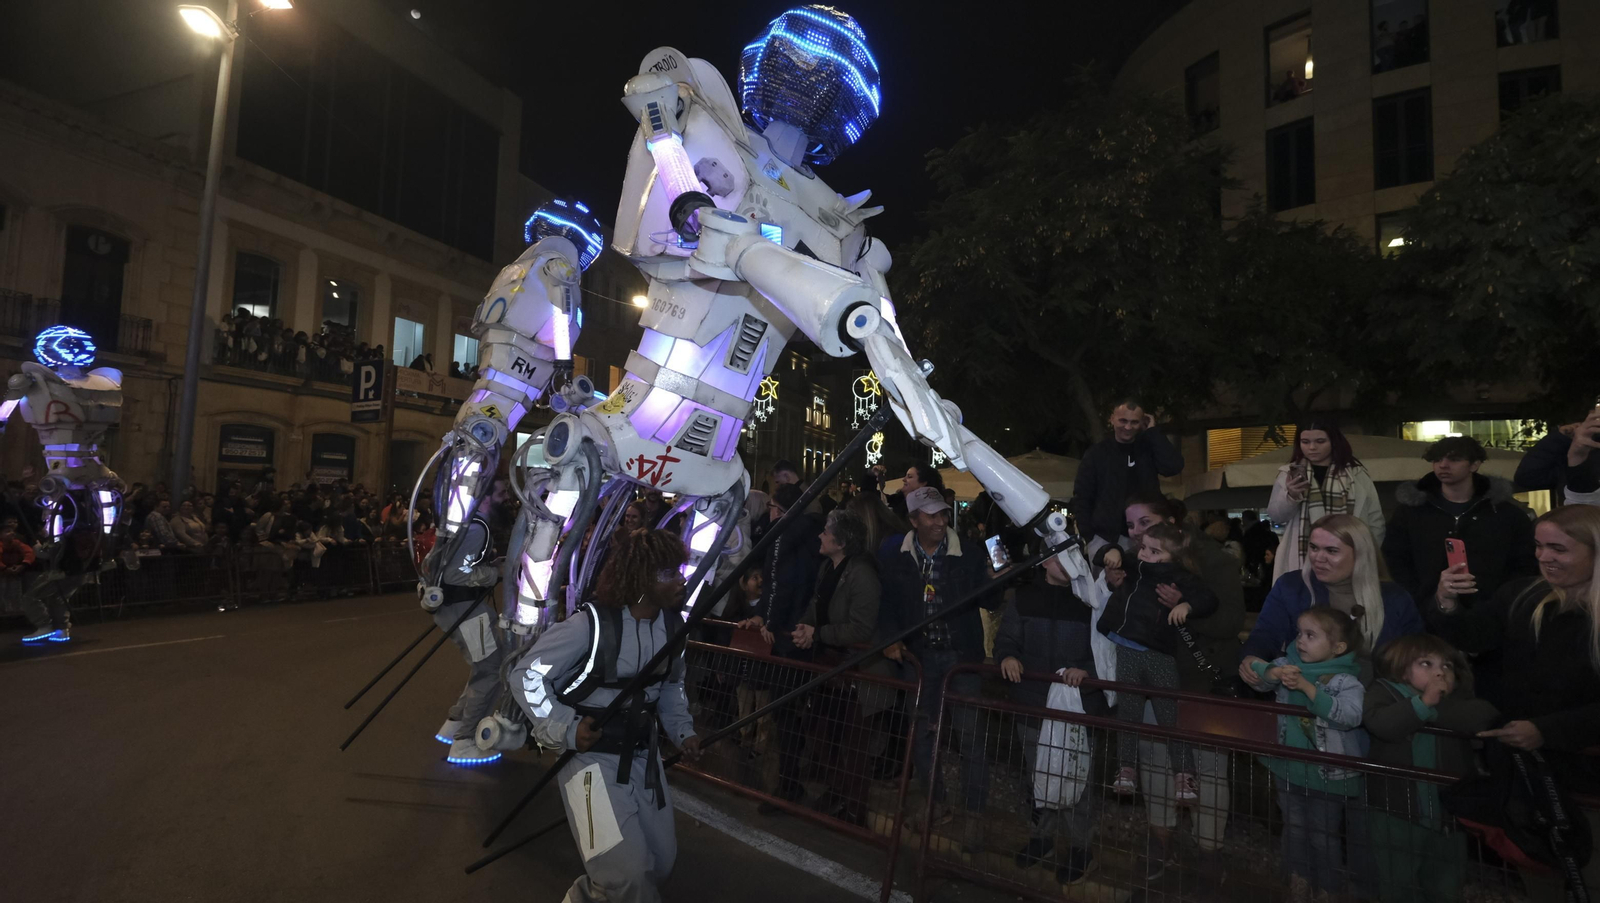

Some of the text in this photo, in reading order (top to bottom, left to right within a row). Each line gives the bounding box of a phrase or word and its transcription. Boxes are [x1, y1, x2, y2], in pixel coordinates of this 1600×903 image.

[651, 297, 686, 320] 160769
[510, 356, 537, 380] RM
[359, 364, 376, 400] P
[1543, 776, 1559, 800] MICKEY
